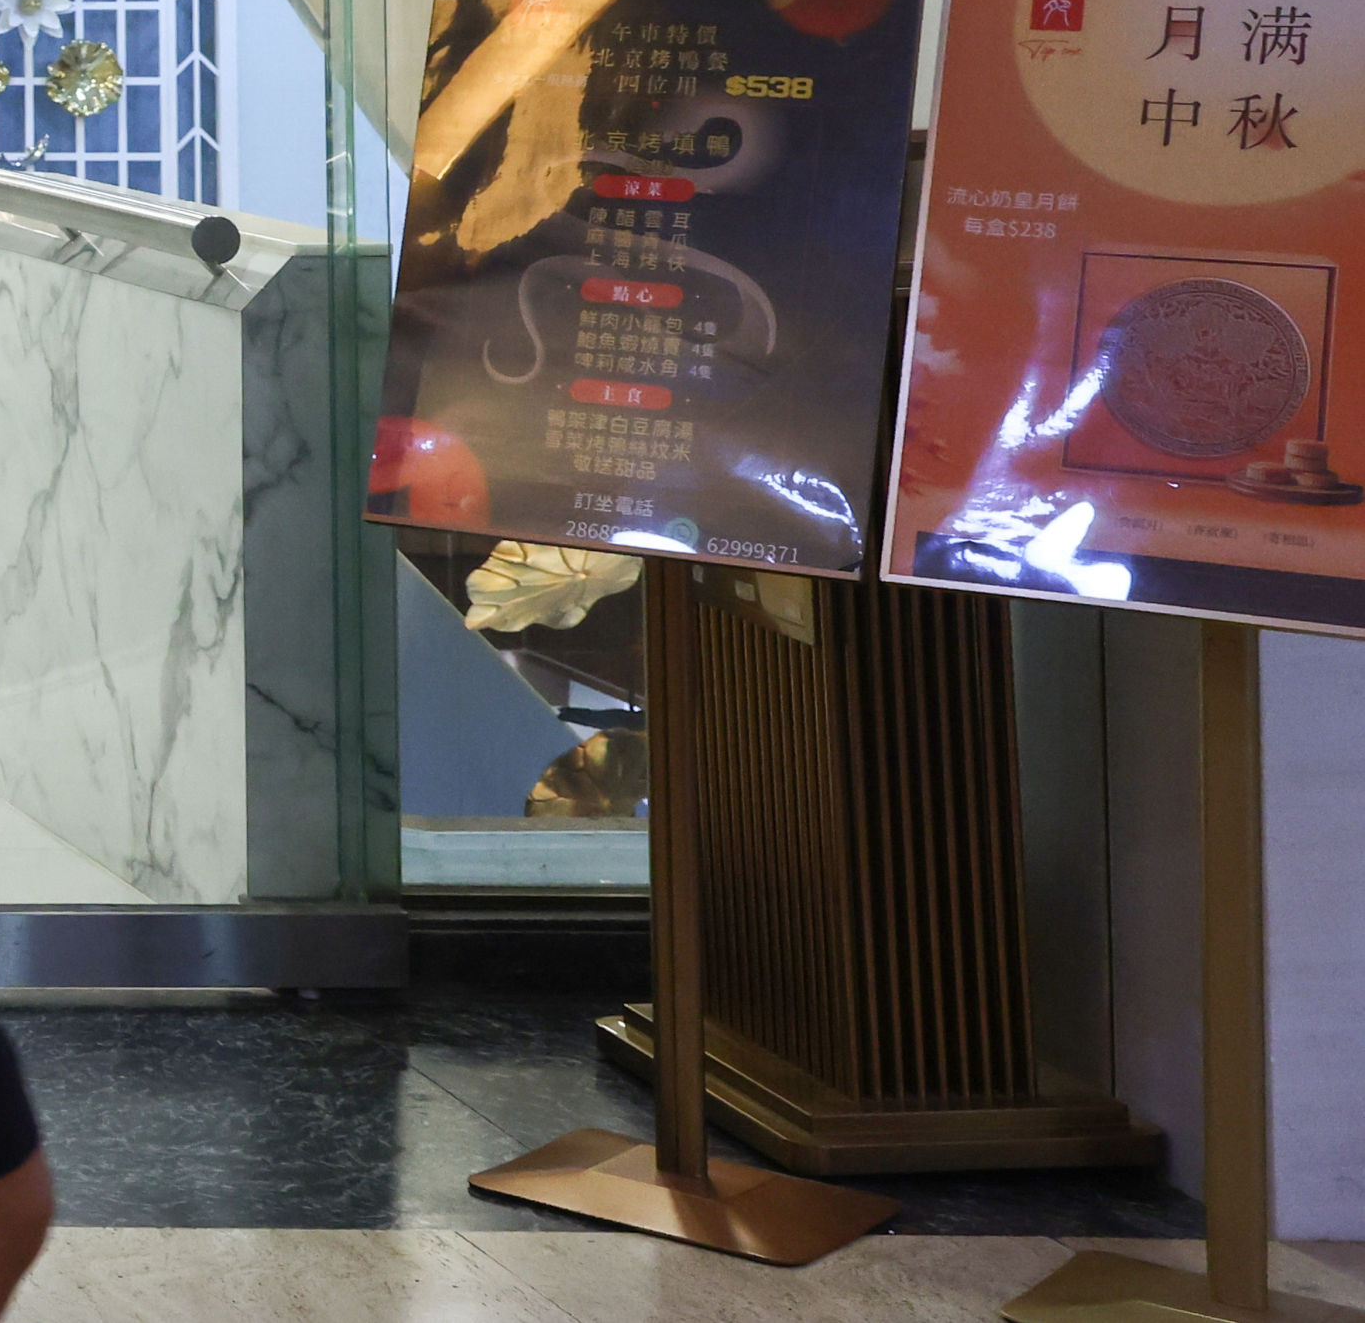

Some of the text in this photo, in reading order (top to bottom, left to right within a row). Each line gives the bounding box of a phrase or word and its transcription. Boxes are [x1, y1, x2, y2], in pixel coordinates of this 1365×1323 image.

[611, 22, 719, 45] 午市特價
[593, 47, 729, 72] 北京烤鴨餐
[616, 74, 698, 96] 四位用
[725, 74, 814, 99] $538
[1140, 88, 1298, 150] 中秋
[946, 186, 1080, 211] 流心奶皇月餅
[611, 285, 653, 303] 點心
[706, 537, 799, 564] 62999371
